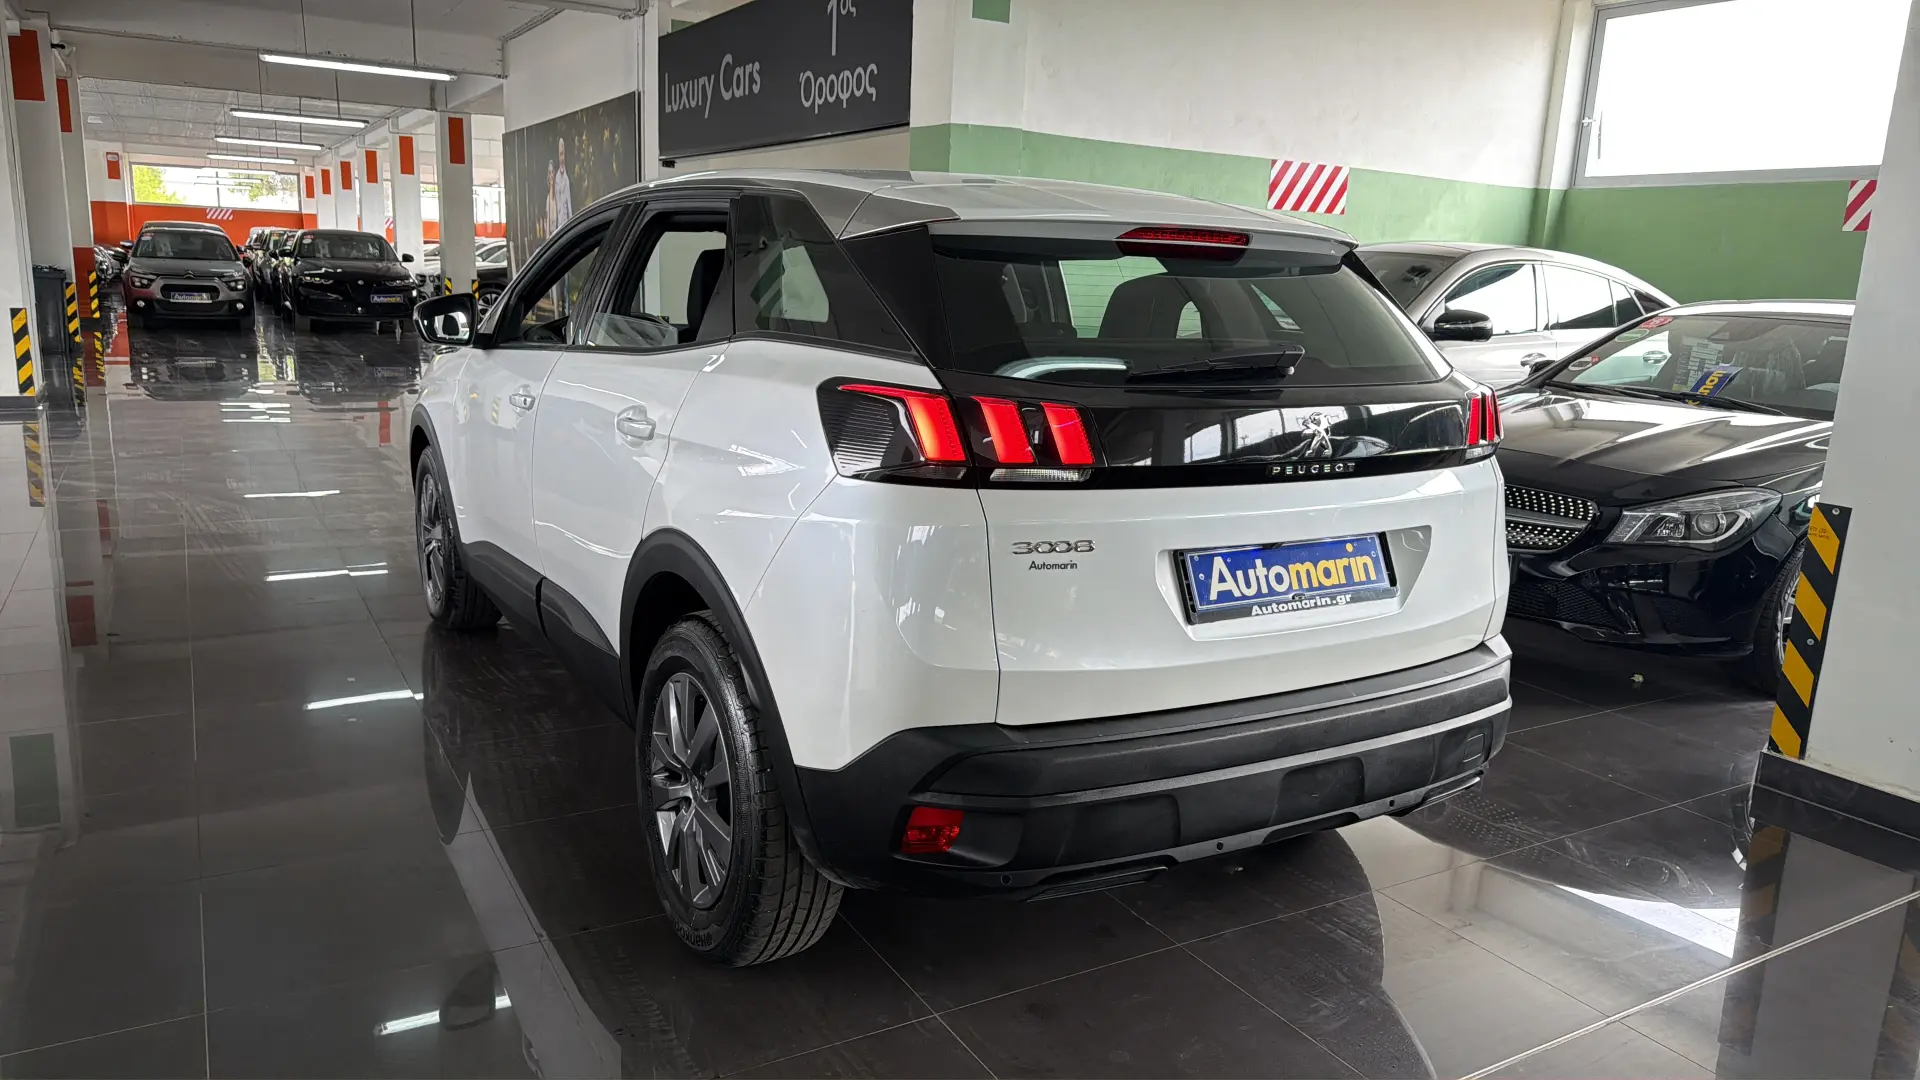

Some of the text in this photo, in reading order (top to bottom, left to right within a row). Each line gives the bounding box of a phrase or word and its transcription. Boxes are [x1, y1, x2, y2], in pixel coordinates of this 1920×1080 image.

[665, 53, 761, 118] Luxury Cars
[799, 63, 878, 114] Όροφος
[1271, 463, 1356, 475] PEUGEOT
[1011, 540, 1096, 555] 3008
[1028, 560, 1078, 570] Automarin
[1209, 543, 1377, 601] Automarin
[1251, 593, 1352, 616] Automarin.gr
